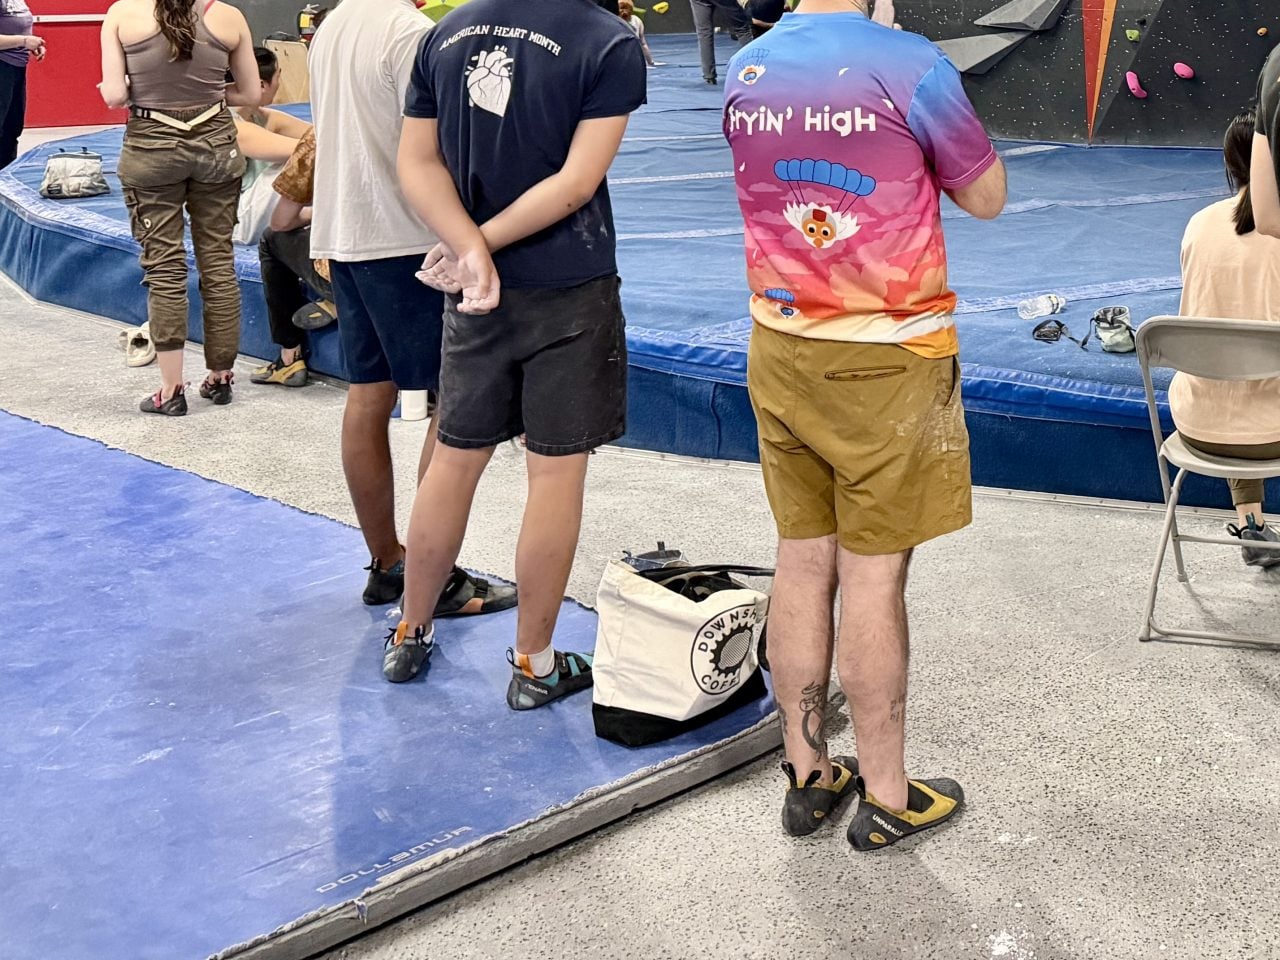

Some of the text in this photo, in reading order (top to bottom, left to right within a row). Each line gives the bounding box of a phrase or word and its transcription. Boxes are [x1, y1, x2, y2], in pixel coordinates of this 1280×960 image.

[439, 25, 562, 57] AMERICAN HEART MONTH
